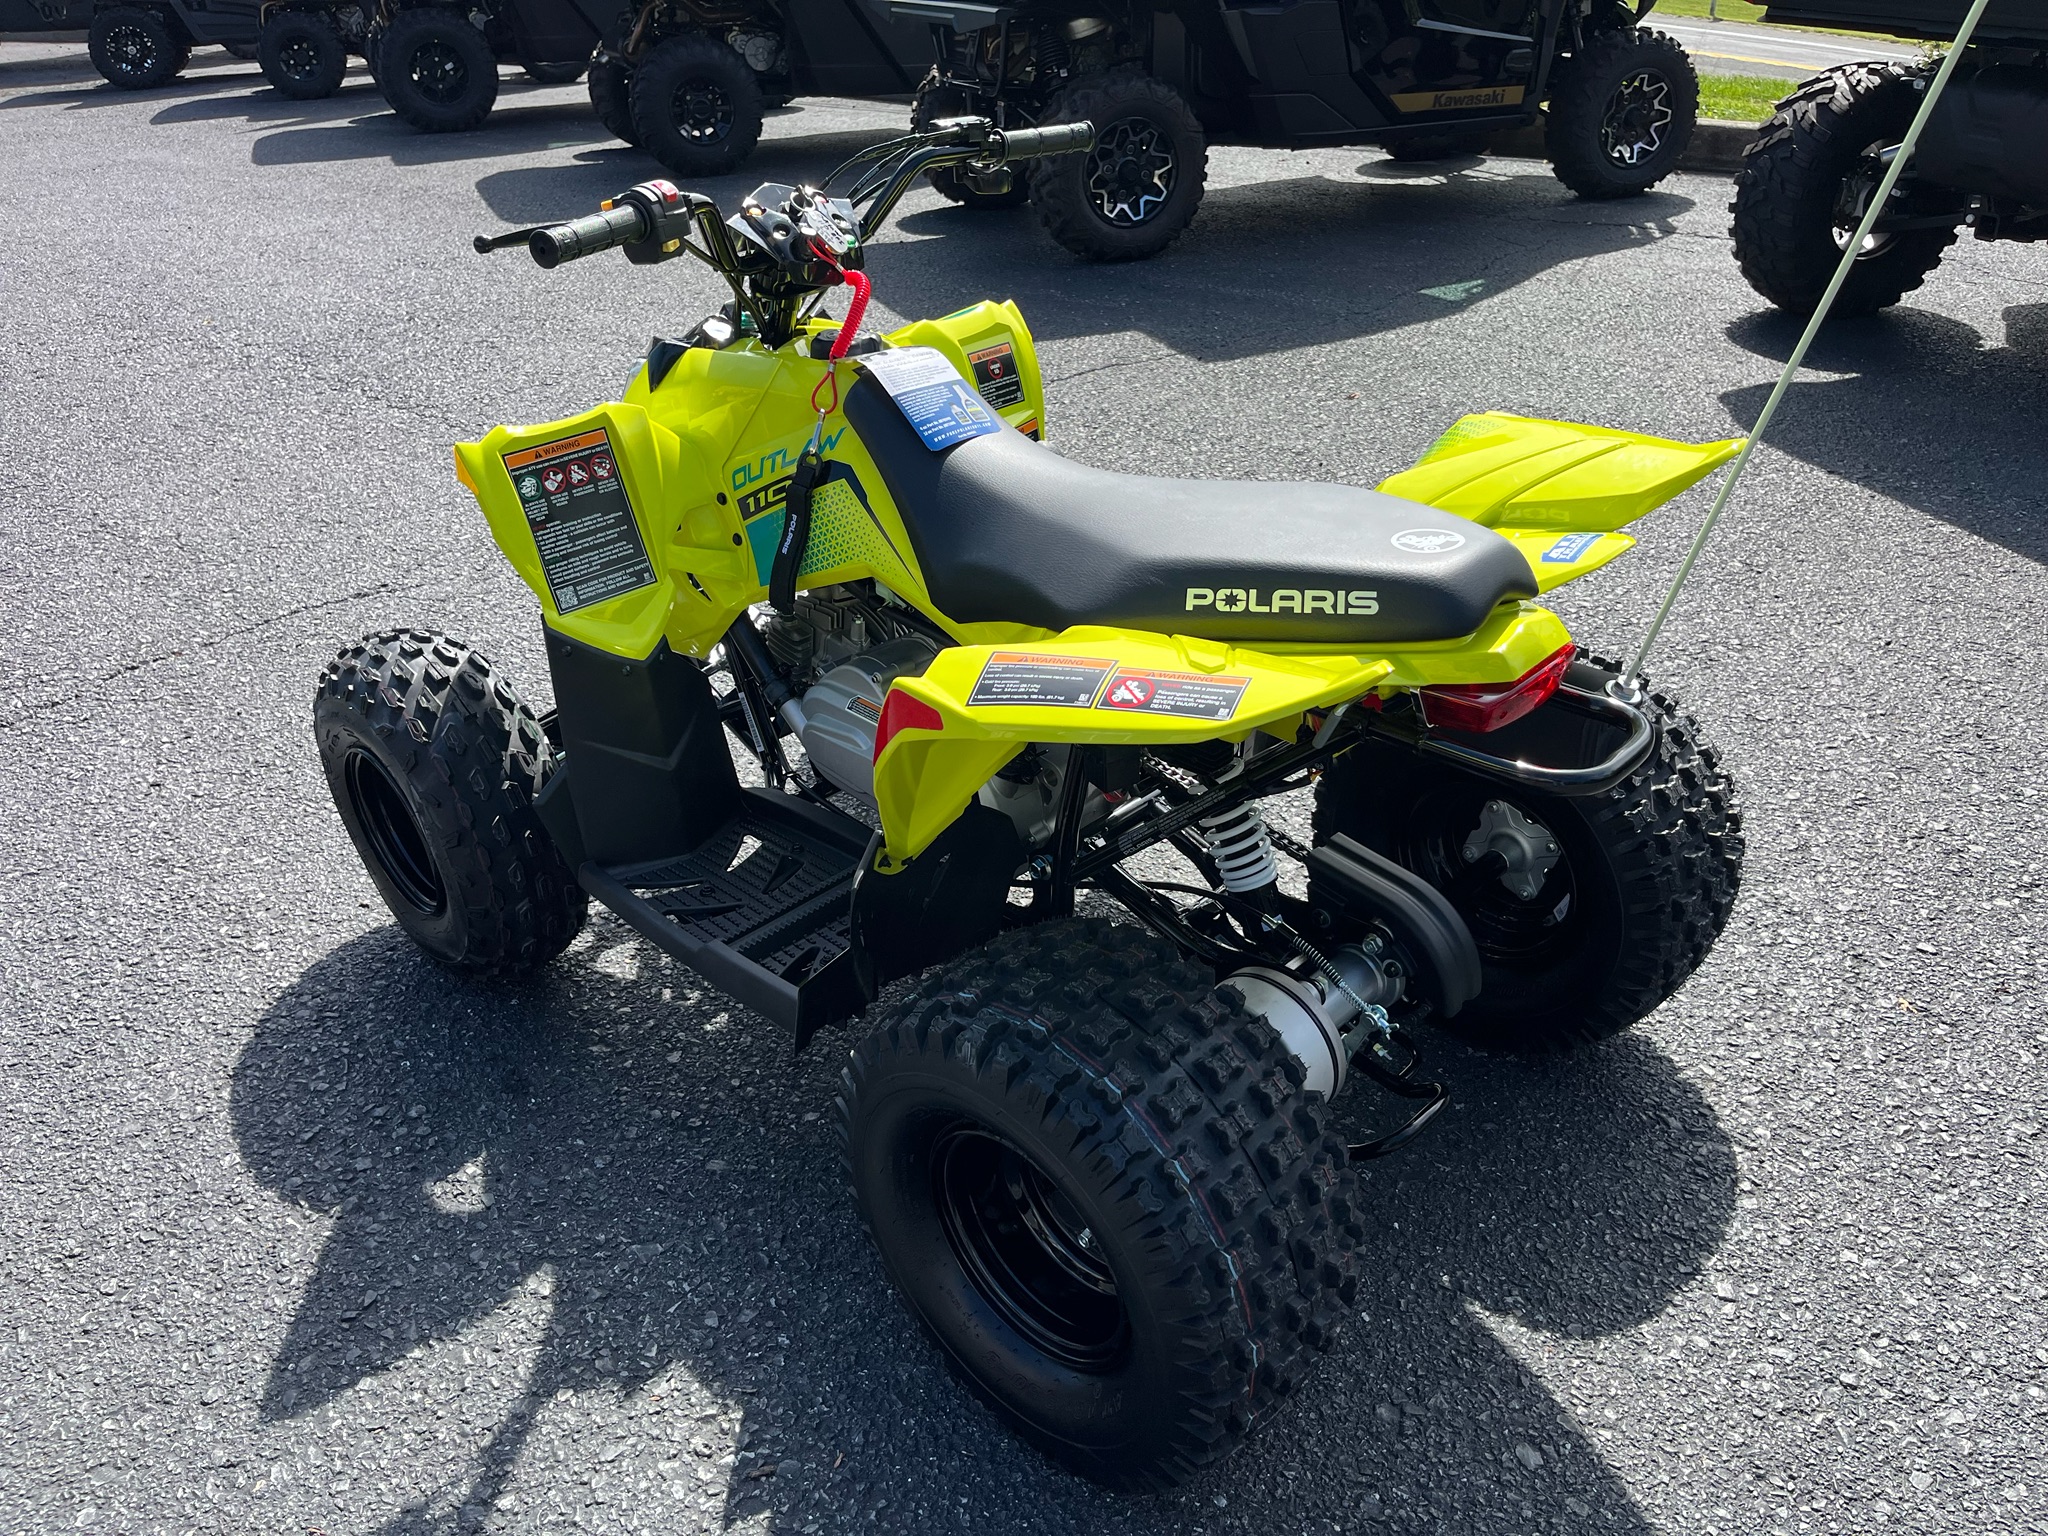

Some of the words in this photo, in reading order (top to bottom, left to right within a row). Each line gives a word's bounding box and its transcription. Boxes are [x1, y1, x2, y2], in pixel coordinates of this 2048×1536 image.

[1432, 89, 1506, 108] Kawasaki
[543, 440, 580, 456] WARNING
[782, 513, 798, 555] POLARIS
[1185, 587, 1379, 615] POLARIS
[1158, 672, 1214, 682] WARNING
